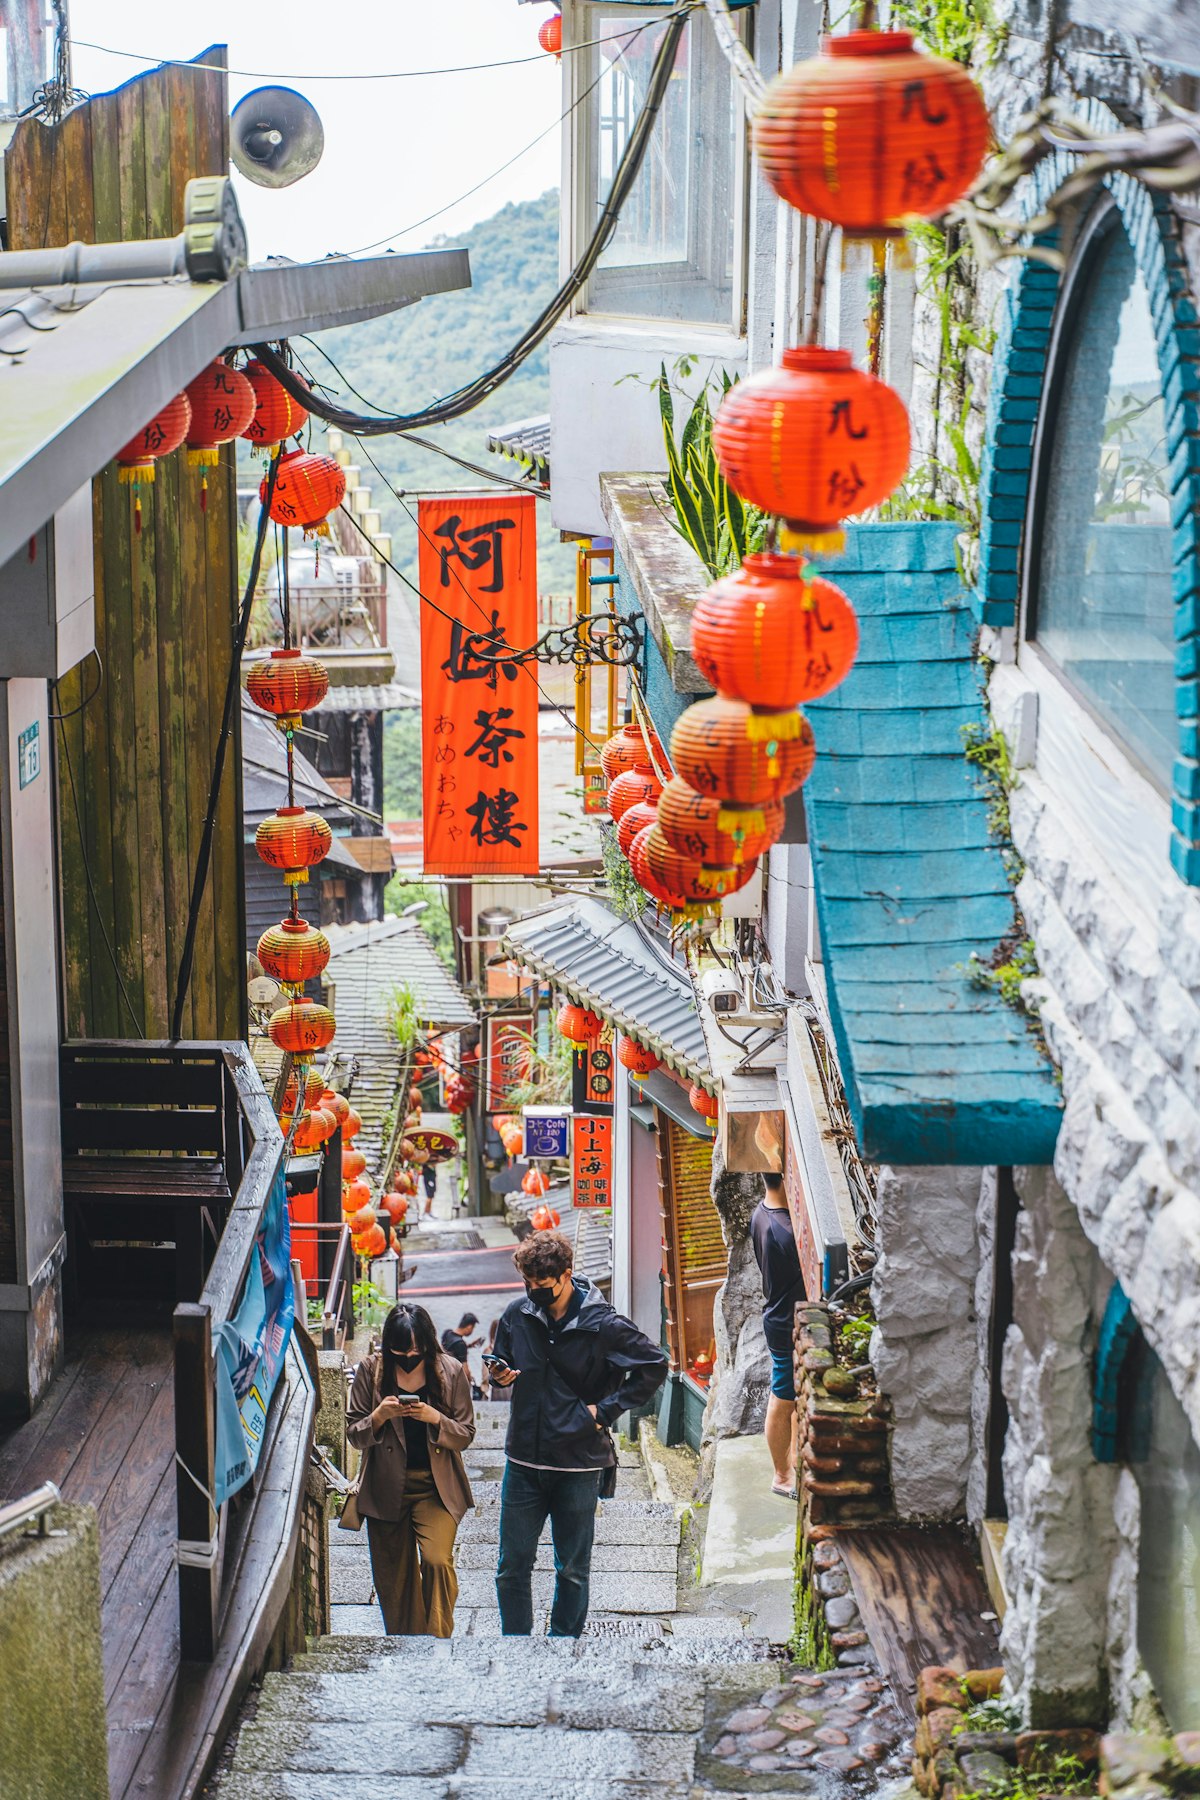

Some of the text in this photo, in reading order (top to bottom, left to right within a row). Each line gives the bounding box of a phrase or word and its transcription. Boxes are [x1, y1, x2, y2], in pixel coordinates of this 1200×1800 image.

[900, 80, 949, 205] 九份
[213, 373, 235, 431] 九份
[144, 422, 167, 450] 份
[828, 400, 867, 507] 九份
[262, 664, 277, 706] 九份
[433, 515, 528, 849] 阿妹茶樓
[29, 744, 37, 775] 15
[694, 720, 721, 792] 九份
[433, 714, 463, 843] あめおちゃ
[311, 823, 326, 862] 九份
[684, 793, 711, 858] 九份
[303, 1010, 318, 1044] 九份
[582, 1016, 594, 1040] 九份
[635, 1044, 647, 1071] 九份
[579, 1120, 608, 1175] 小上海
[577, 1179, 608, 1190] 咖啡
[577, 1193, 607, 1204] 茶樓
